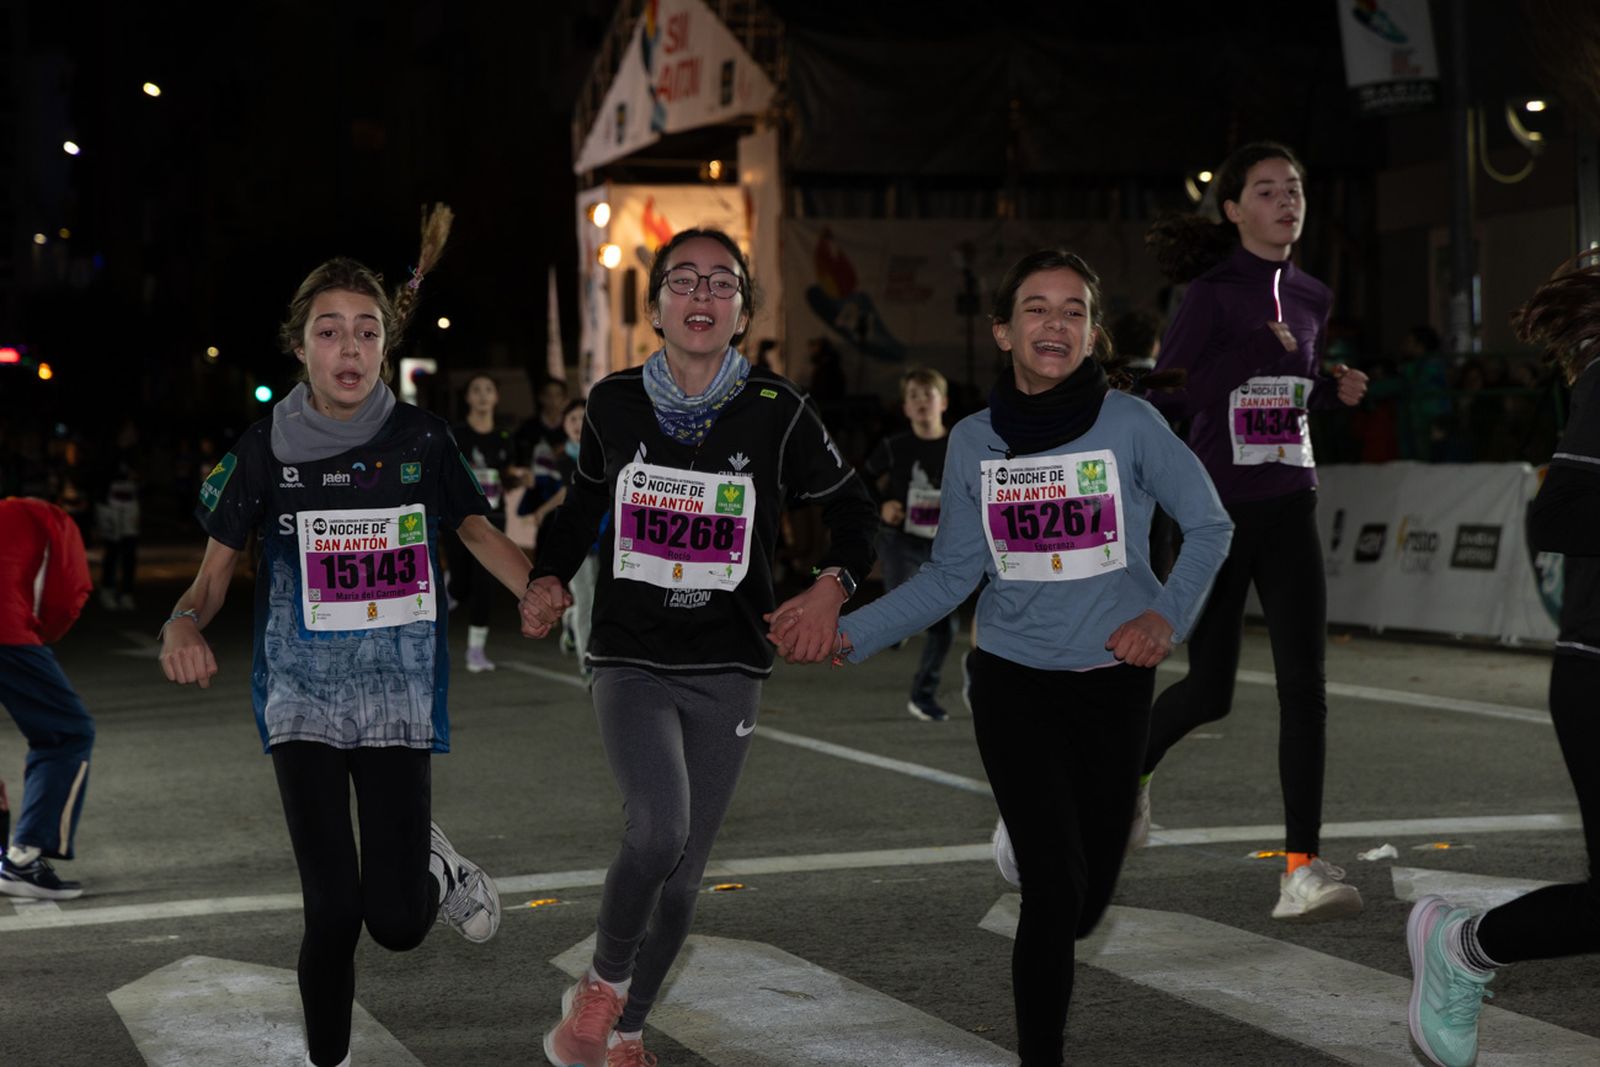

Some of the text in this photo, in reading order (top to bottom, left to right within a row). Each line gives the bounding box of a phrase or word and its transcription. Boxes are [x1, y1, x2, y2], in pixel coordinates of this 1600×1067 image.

[1241, 398, 1258, 407] SAN
[1242, 408, 1299, 435] 1434
[633, 474, 646, 484] 43
[1009, 470, 1064, 485] NOCHE DE
[647, 480, 687, 496] NOCHE
[689, 485, 706, 498] DE
[996, 488, 1021, 502] SAN
[1023, 483, 1067, 500] ANTÓN
[631, 492, 704, 513] SAN ANTÓN
[314, 520, 327, 530] 43
[1001, 498, 1102, 540] 15267
[329, 522, 387, 536] NOCHE DE
[631, 508, 735, 551] 15268
[314, 539, 341, 552] SAN
[343, 535, 388, 551] ANTÓN
[320, 549, 416, 589] 15143
